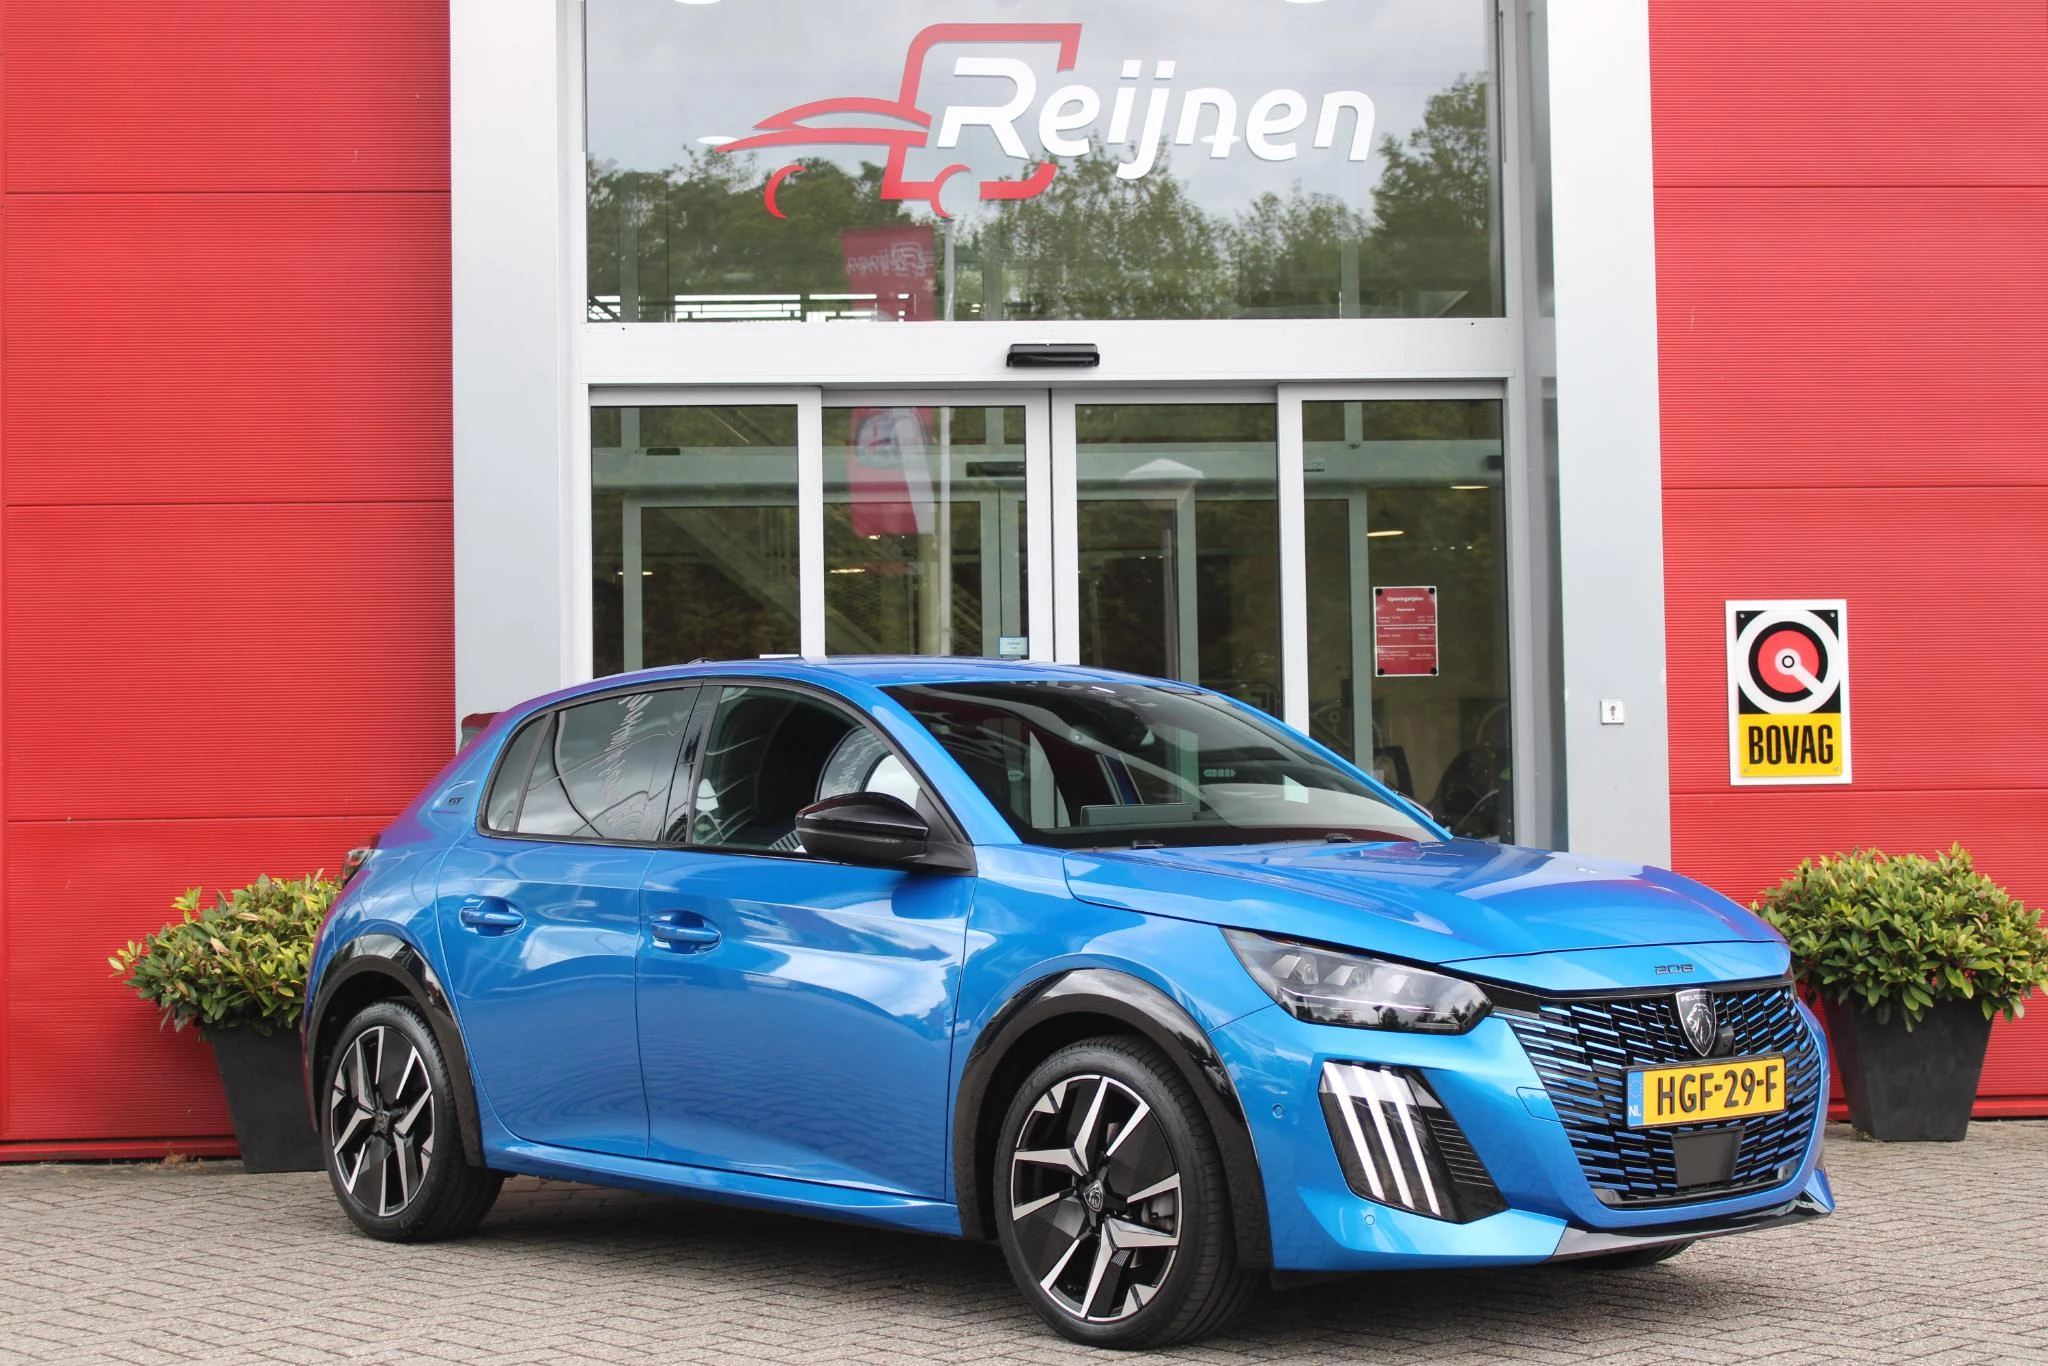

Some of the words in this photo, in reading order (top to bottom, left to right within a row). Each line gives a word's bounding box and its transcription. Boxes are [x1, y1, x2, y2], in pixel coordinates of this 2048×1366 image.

[937, 57, 1376, 180] Reijnen
[1748, 724, 1834, 765] BOVAG
[448, 797, 464, 805] GT
[1654, 963, 1696, 975] 208
[1657, 1065, 1778, 1116] HGF-29-F
[1628, 1105, 1641, 1117] NL
